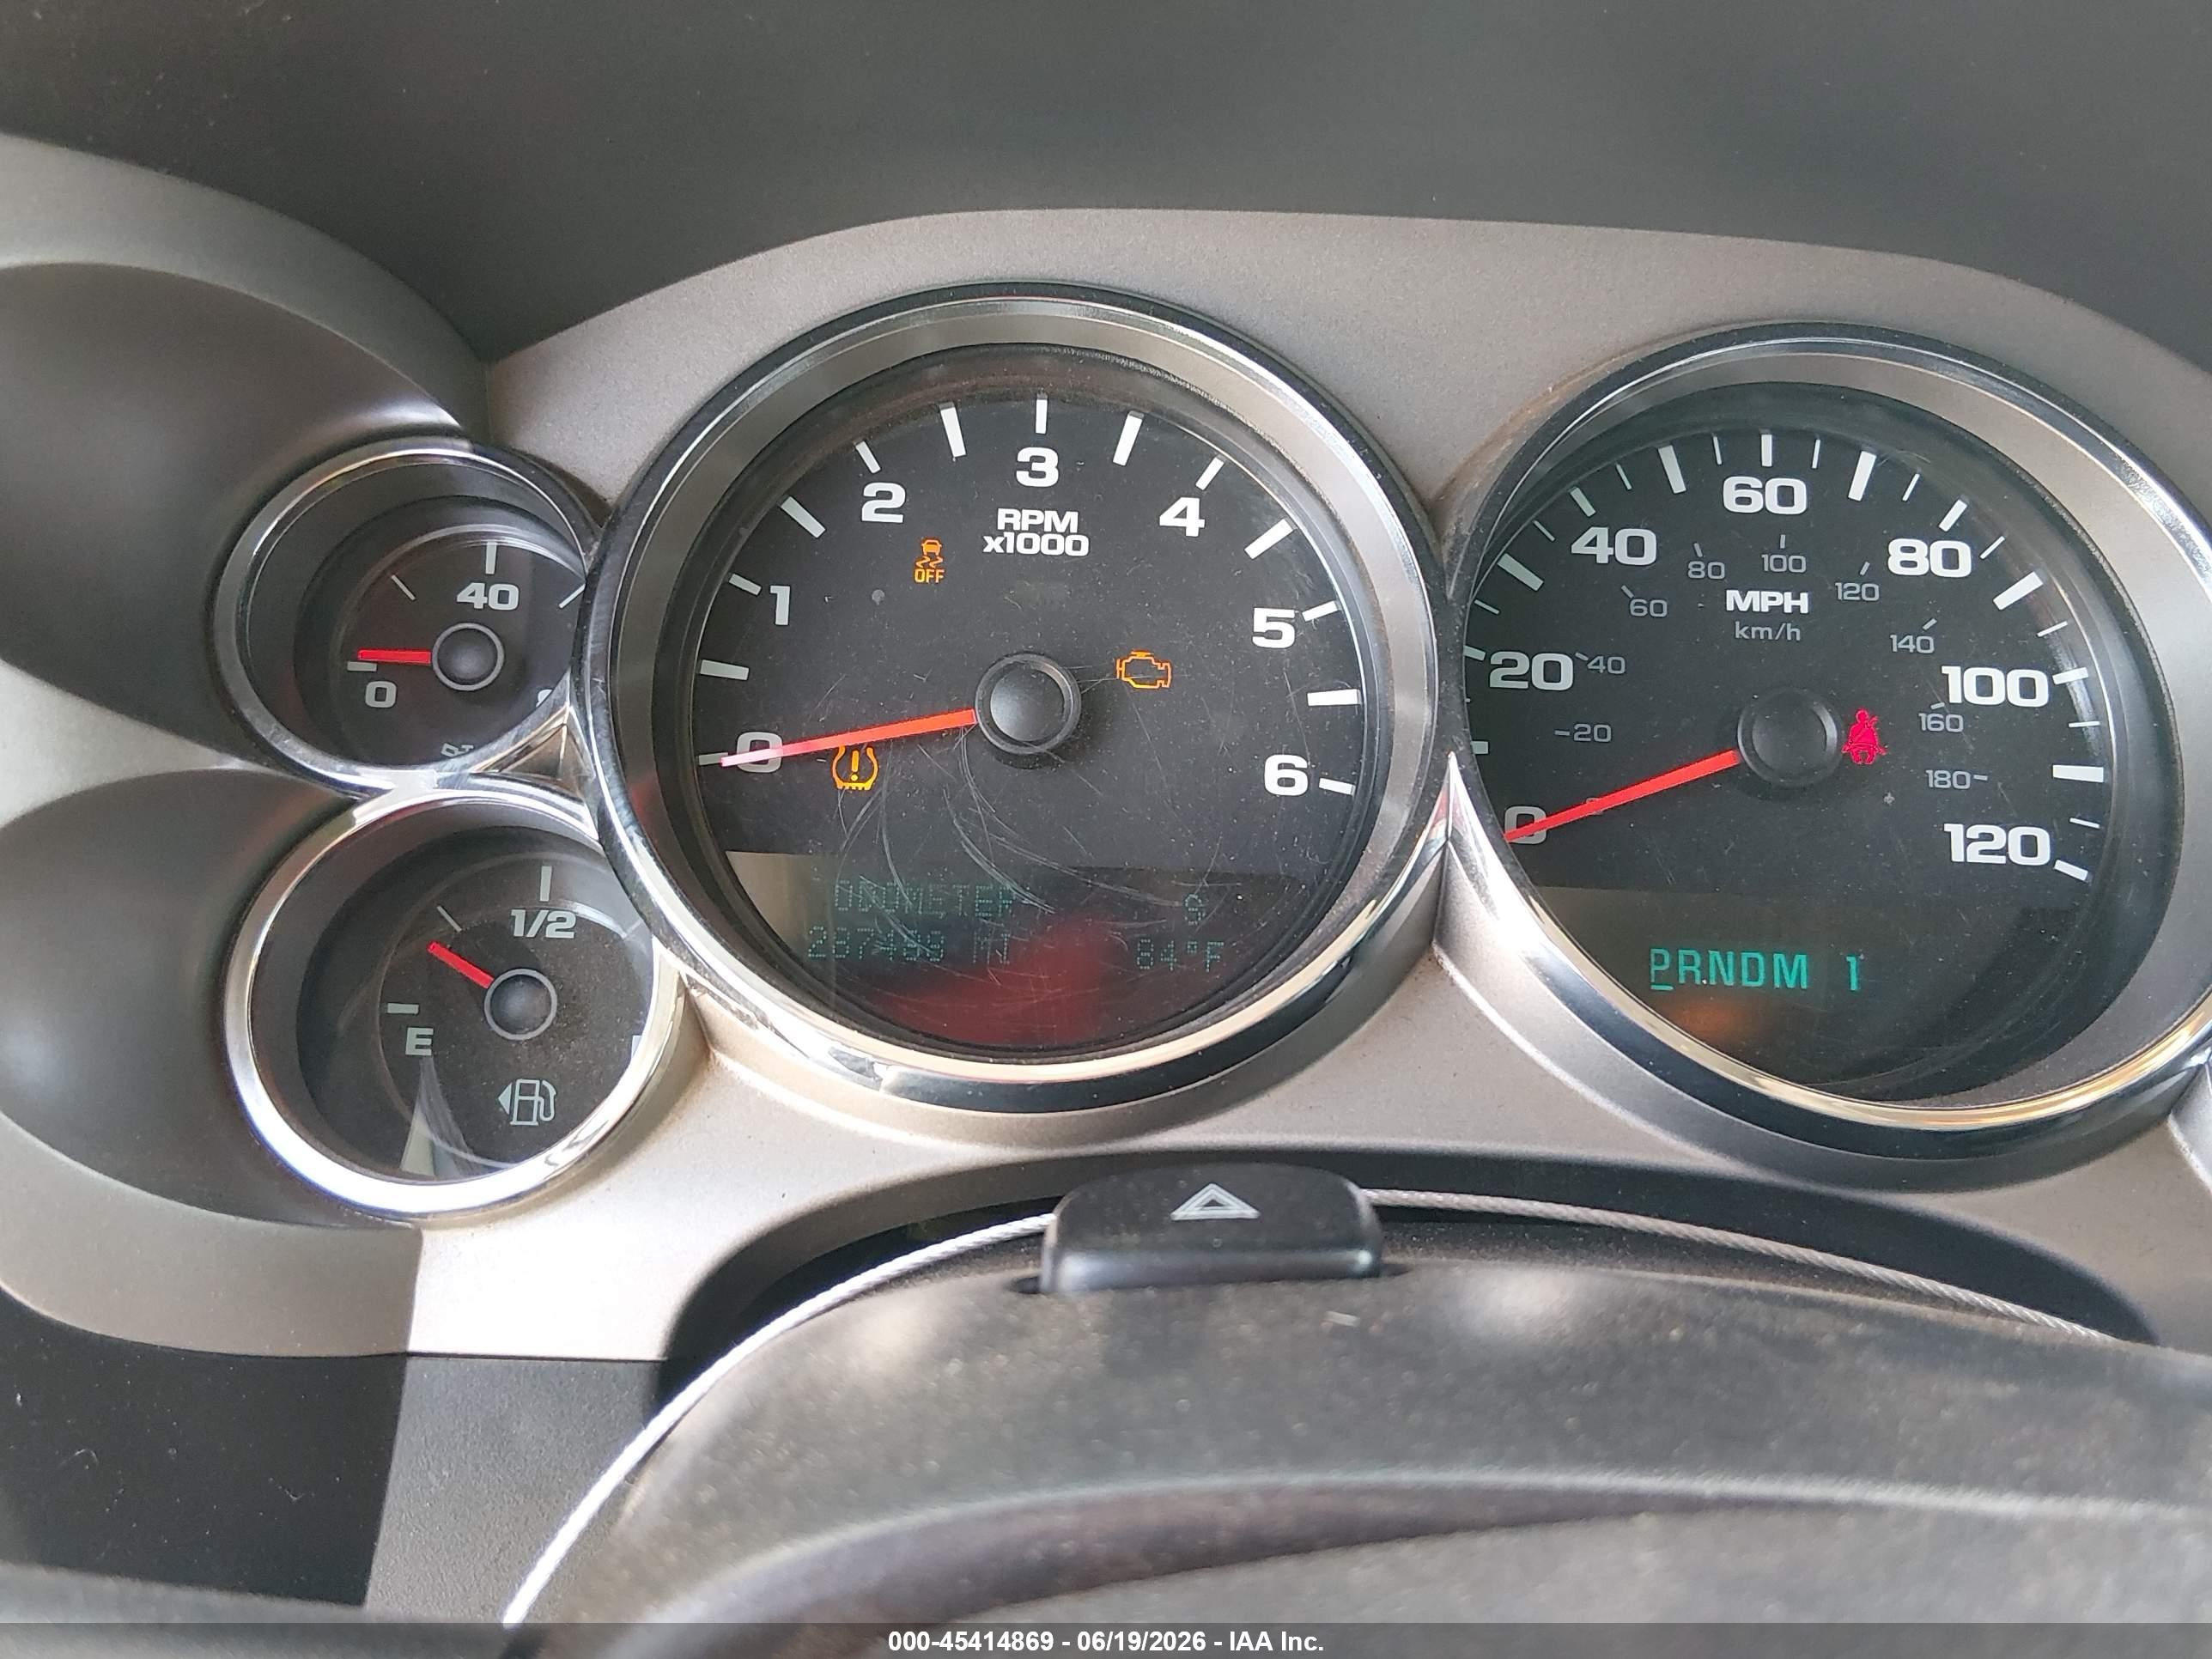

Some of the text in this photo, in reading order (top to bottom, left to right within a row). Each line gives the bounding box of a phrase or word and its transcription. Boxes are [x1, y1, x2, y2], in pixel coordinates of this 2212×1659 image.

[1016, 447, 1059, 488] 3
[861, 482, 906, 524] 2
[1723, 476, 1808, 515] 60
[997, 507, 1079, 532] RPM
[1159, 496, 1206, 538] 4
[982, 532, 1090, 556] x1000
[1571, 526, 1657, 566] 40
[1887, 538, 1972, 578] 80
[912, 568, 947, 585] OFF
[1687, 561, 1725, 580] 80
[1761, 554, 1807, 573] 100
[456, 582, 520, 611] 40
[769, 585, 791, 626] 1
[1726, 589, 1809, 614] MPH
[1834, 582, 1880, 601] 120
[1629, 599, 1668, 617] 60
[1252, 607, 1296, 648] 5
[1735, 621, 1801, 641] km/h
[1889, 634, 1935, 653] 140
[1489, 651, 1574, 691] 20
[1587, 655, 1626, 675] 40
[365, 680, 397, 708] 0
[1942, 665, 2049, 708] 100
[1573, 723, 1612, 743] 20
[1918, 713, 1964, 732] 160
[735, 731, 783, 775] 0
[1264, 754, 1309, 796] 6
[1925, 769, 1972, 789] 180
[1504, 805, 1547, 844] 0
[1943, 823, 2051, 866] 120
[511, 908, 576, 939] 1/2
[1650, 947, 1861, 991] PRNDM 1
[404, 1027, 434, 1056] E
